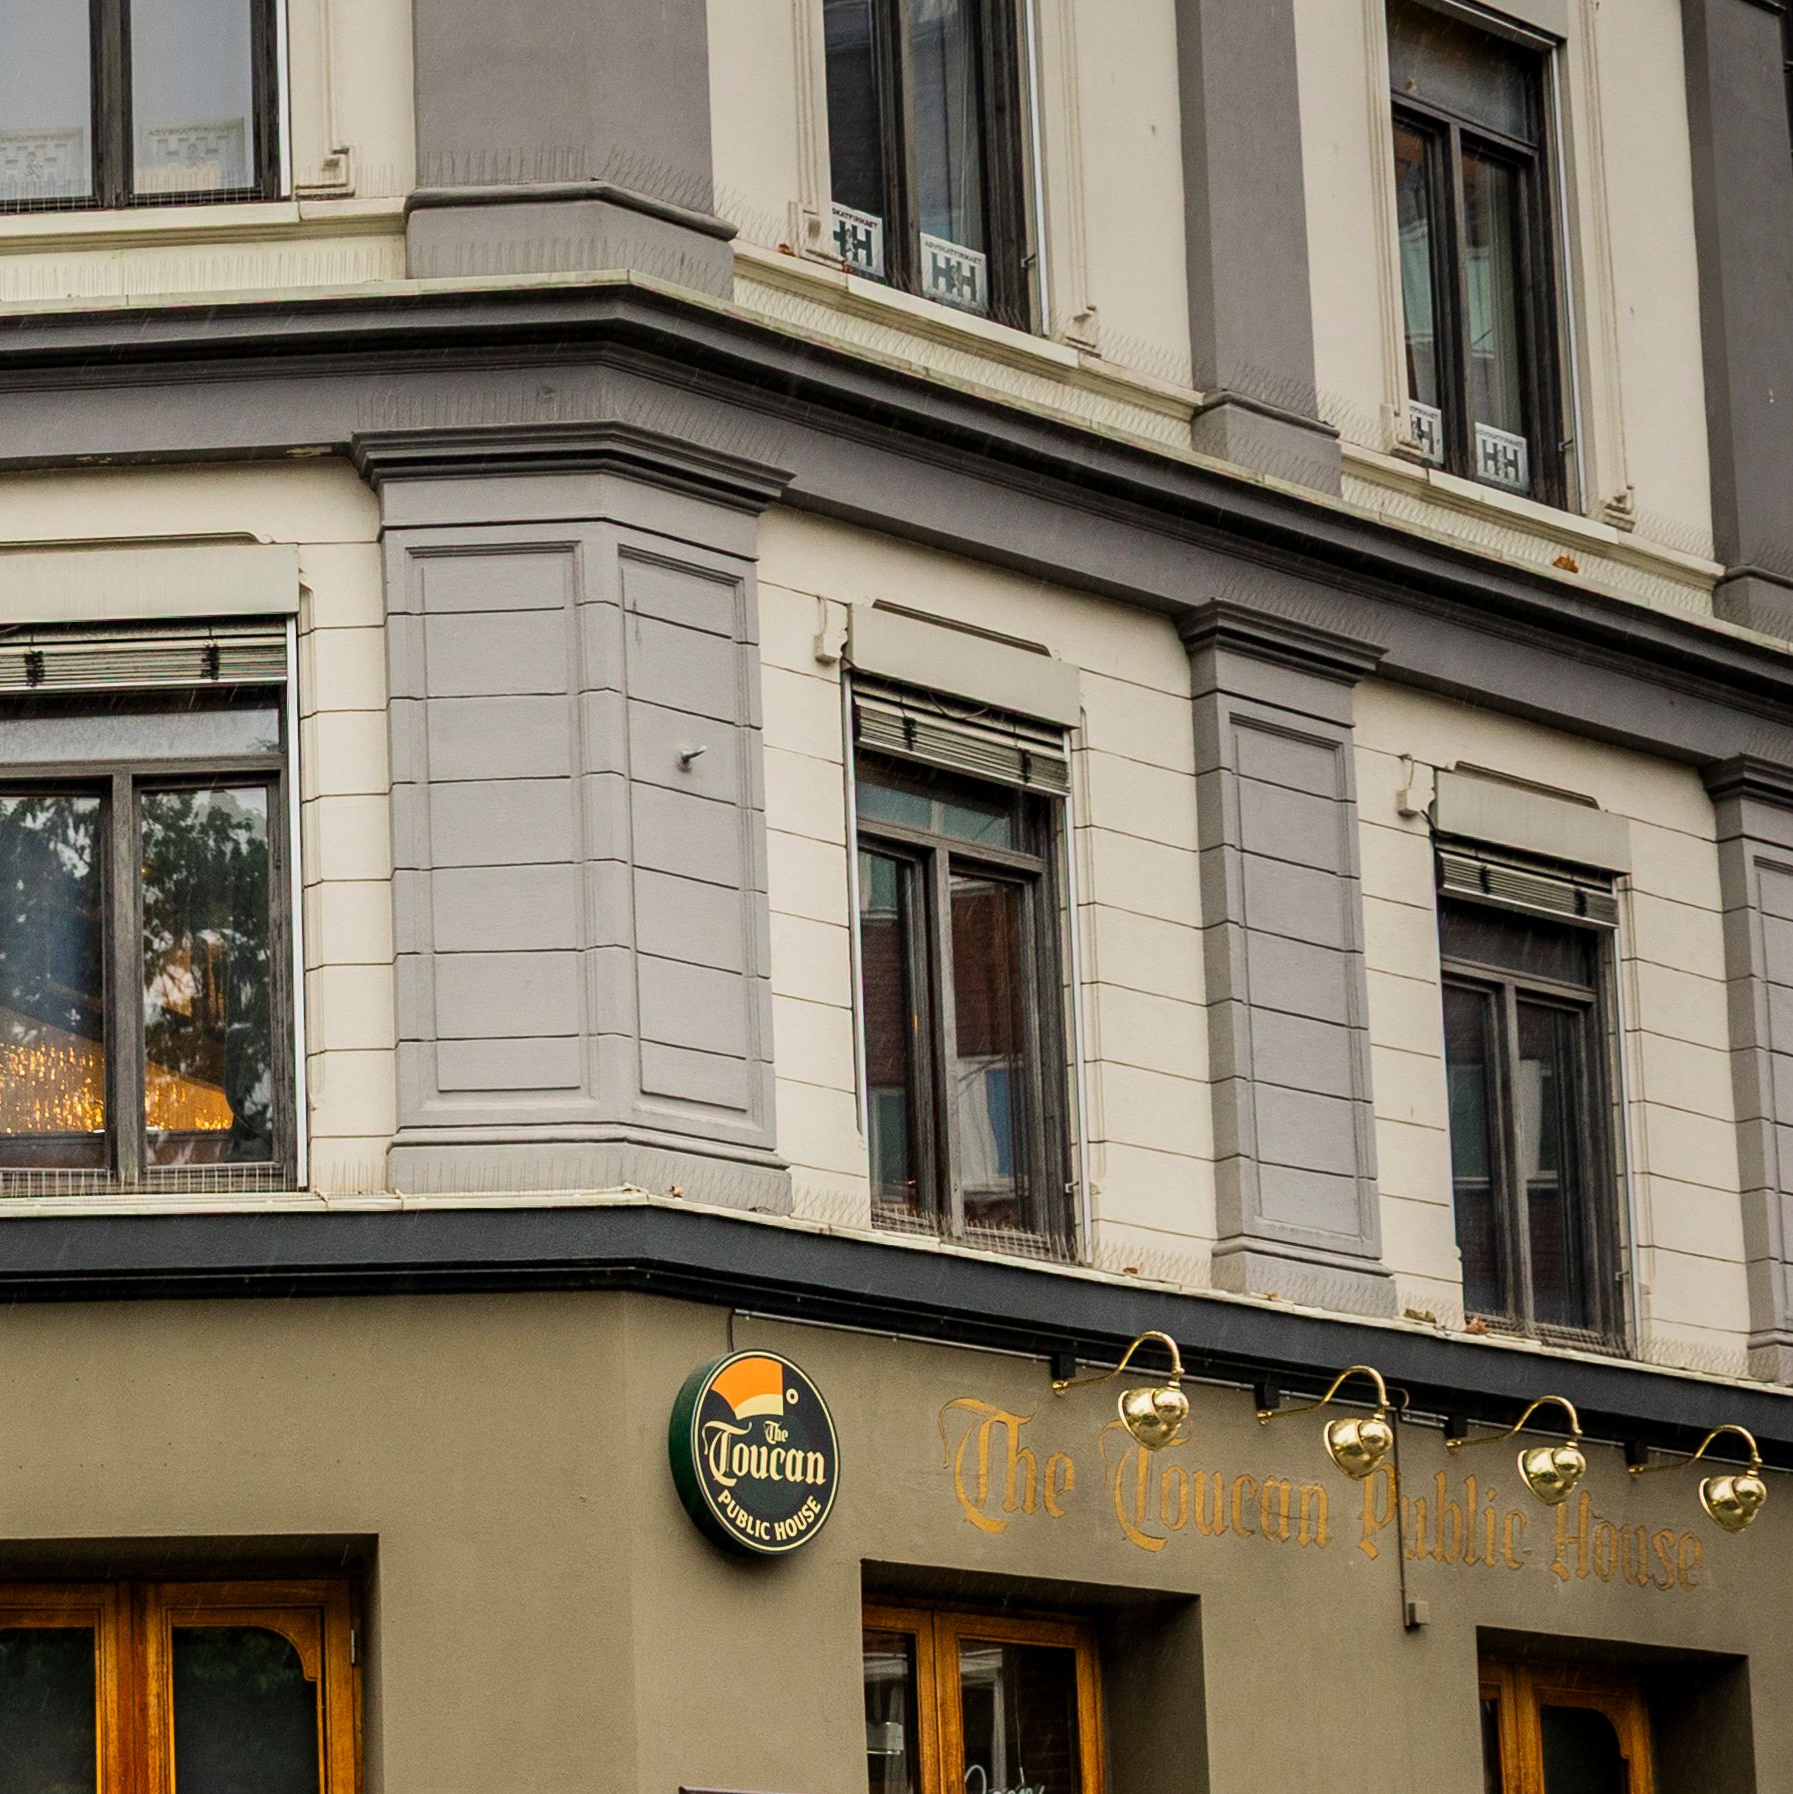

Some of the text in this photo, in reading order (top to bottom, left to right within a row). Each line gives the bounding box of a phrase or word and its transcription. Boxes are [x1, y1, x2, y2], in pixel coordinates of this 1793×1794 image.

[701, 1420, 827, 1488] Toucan
[764, 1420, 789, 1445] The
[717, 1489, 822, 1541] PUBLIC HOUSE
[939, 1397, 1706, 1593] The Toucan Public House
